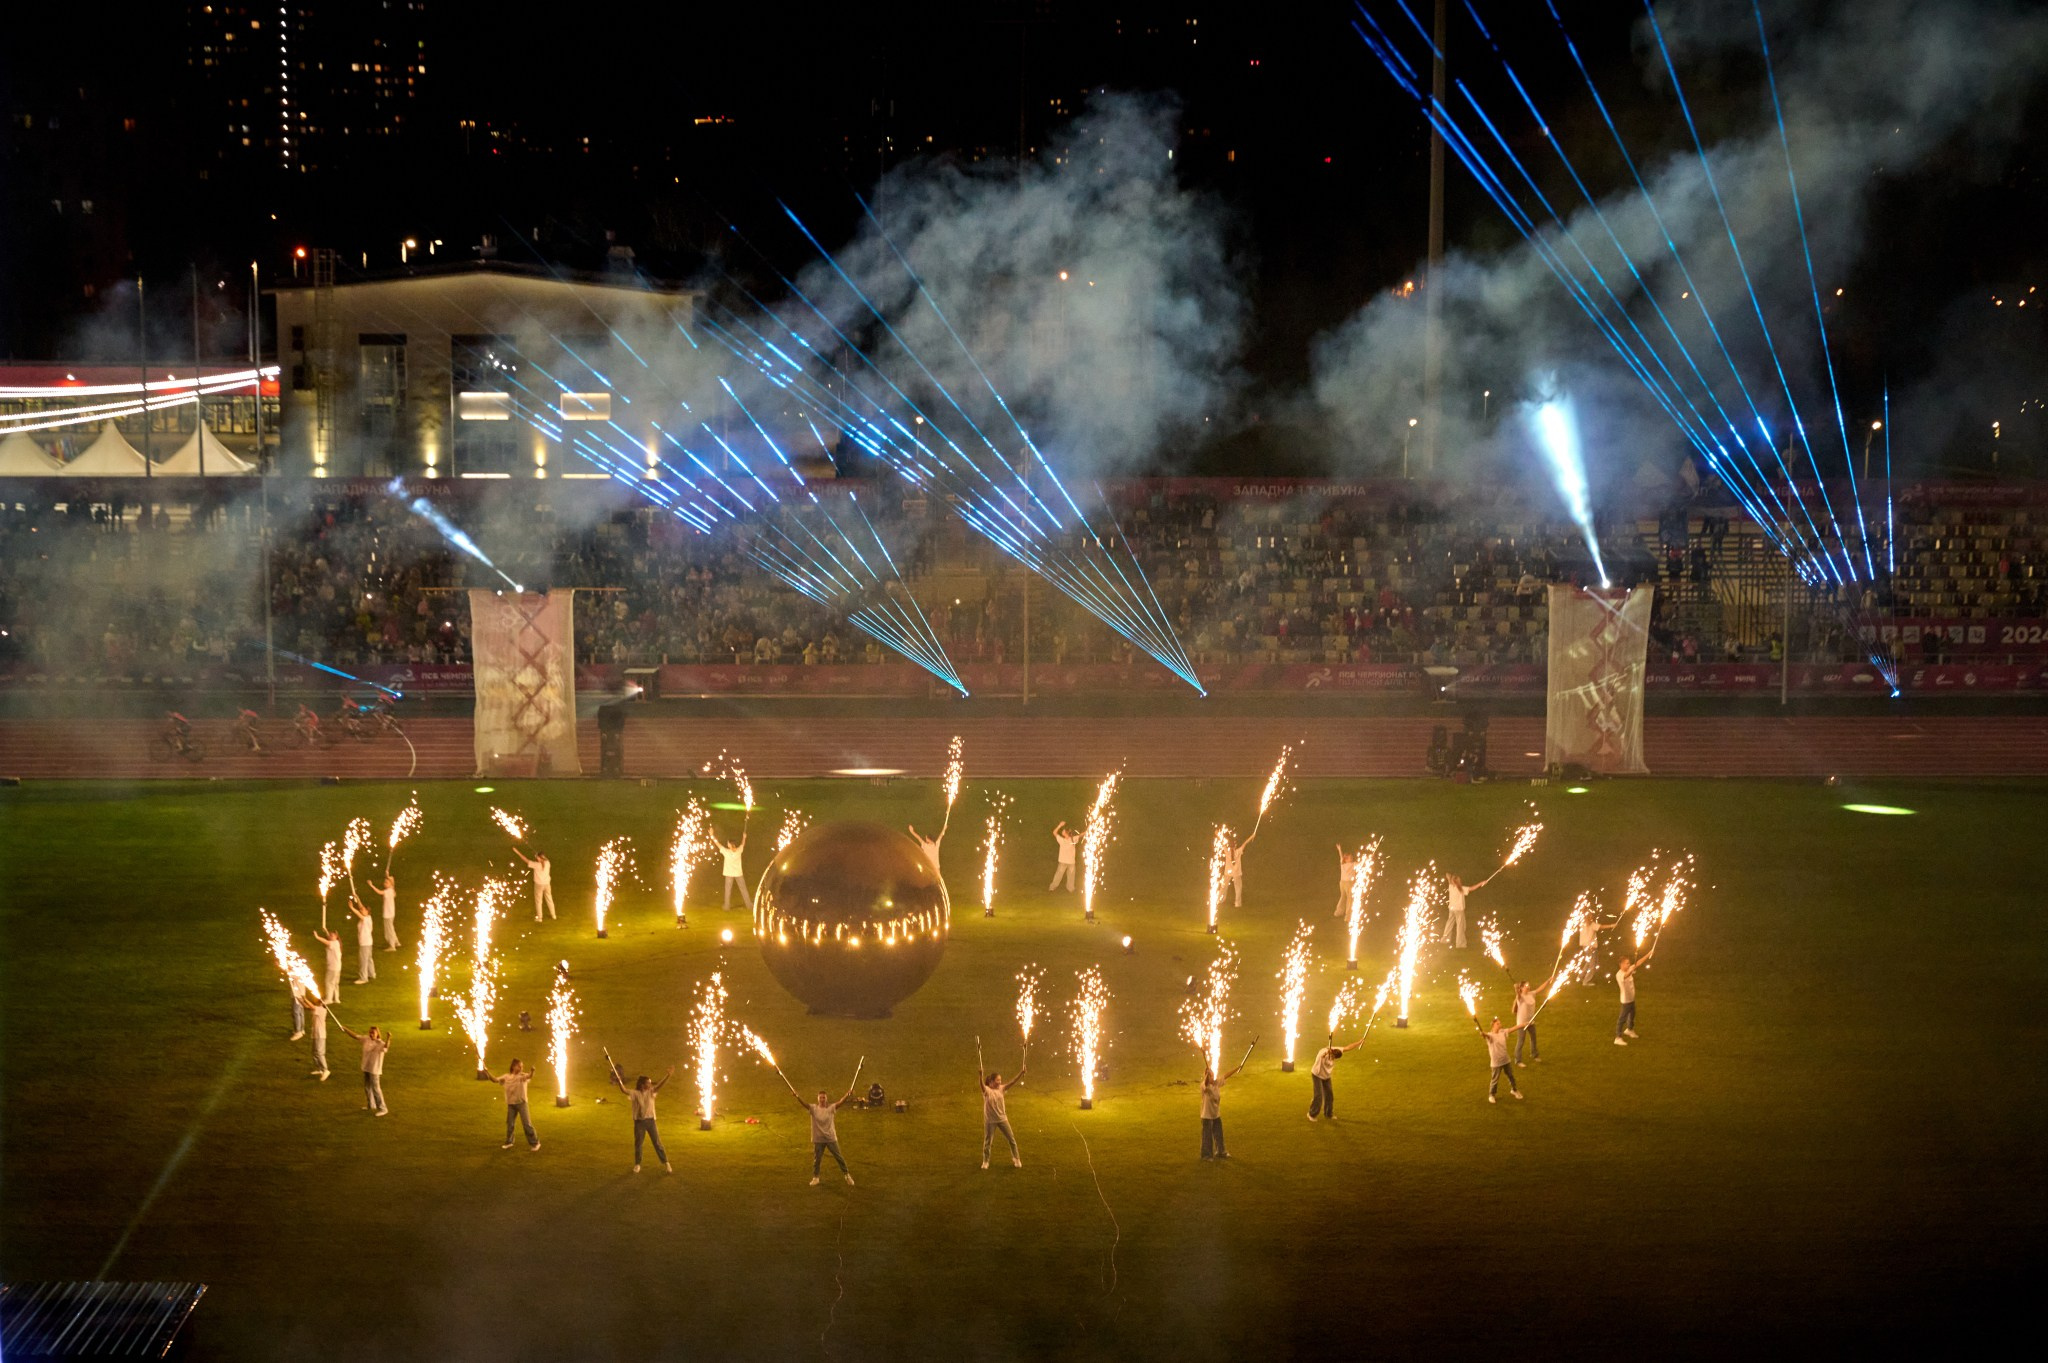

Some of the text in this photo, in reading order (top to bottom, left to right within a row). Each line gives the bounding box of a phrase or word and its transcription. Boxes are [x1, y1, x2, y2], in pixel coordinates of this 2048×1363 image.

[314, 484, 451, 496] ЗАПАДНАЯ ИБУНА
[1233, 485, 1366, 497] ЗАПАДНАЯ ТИБУНА
